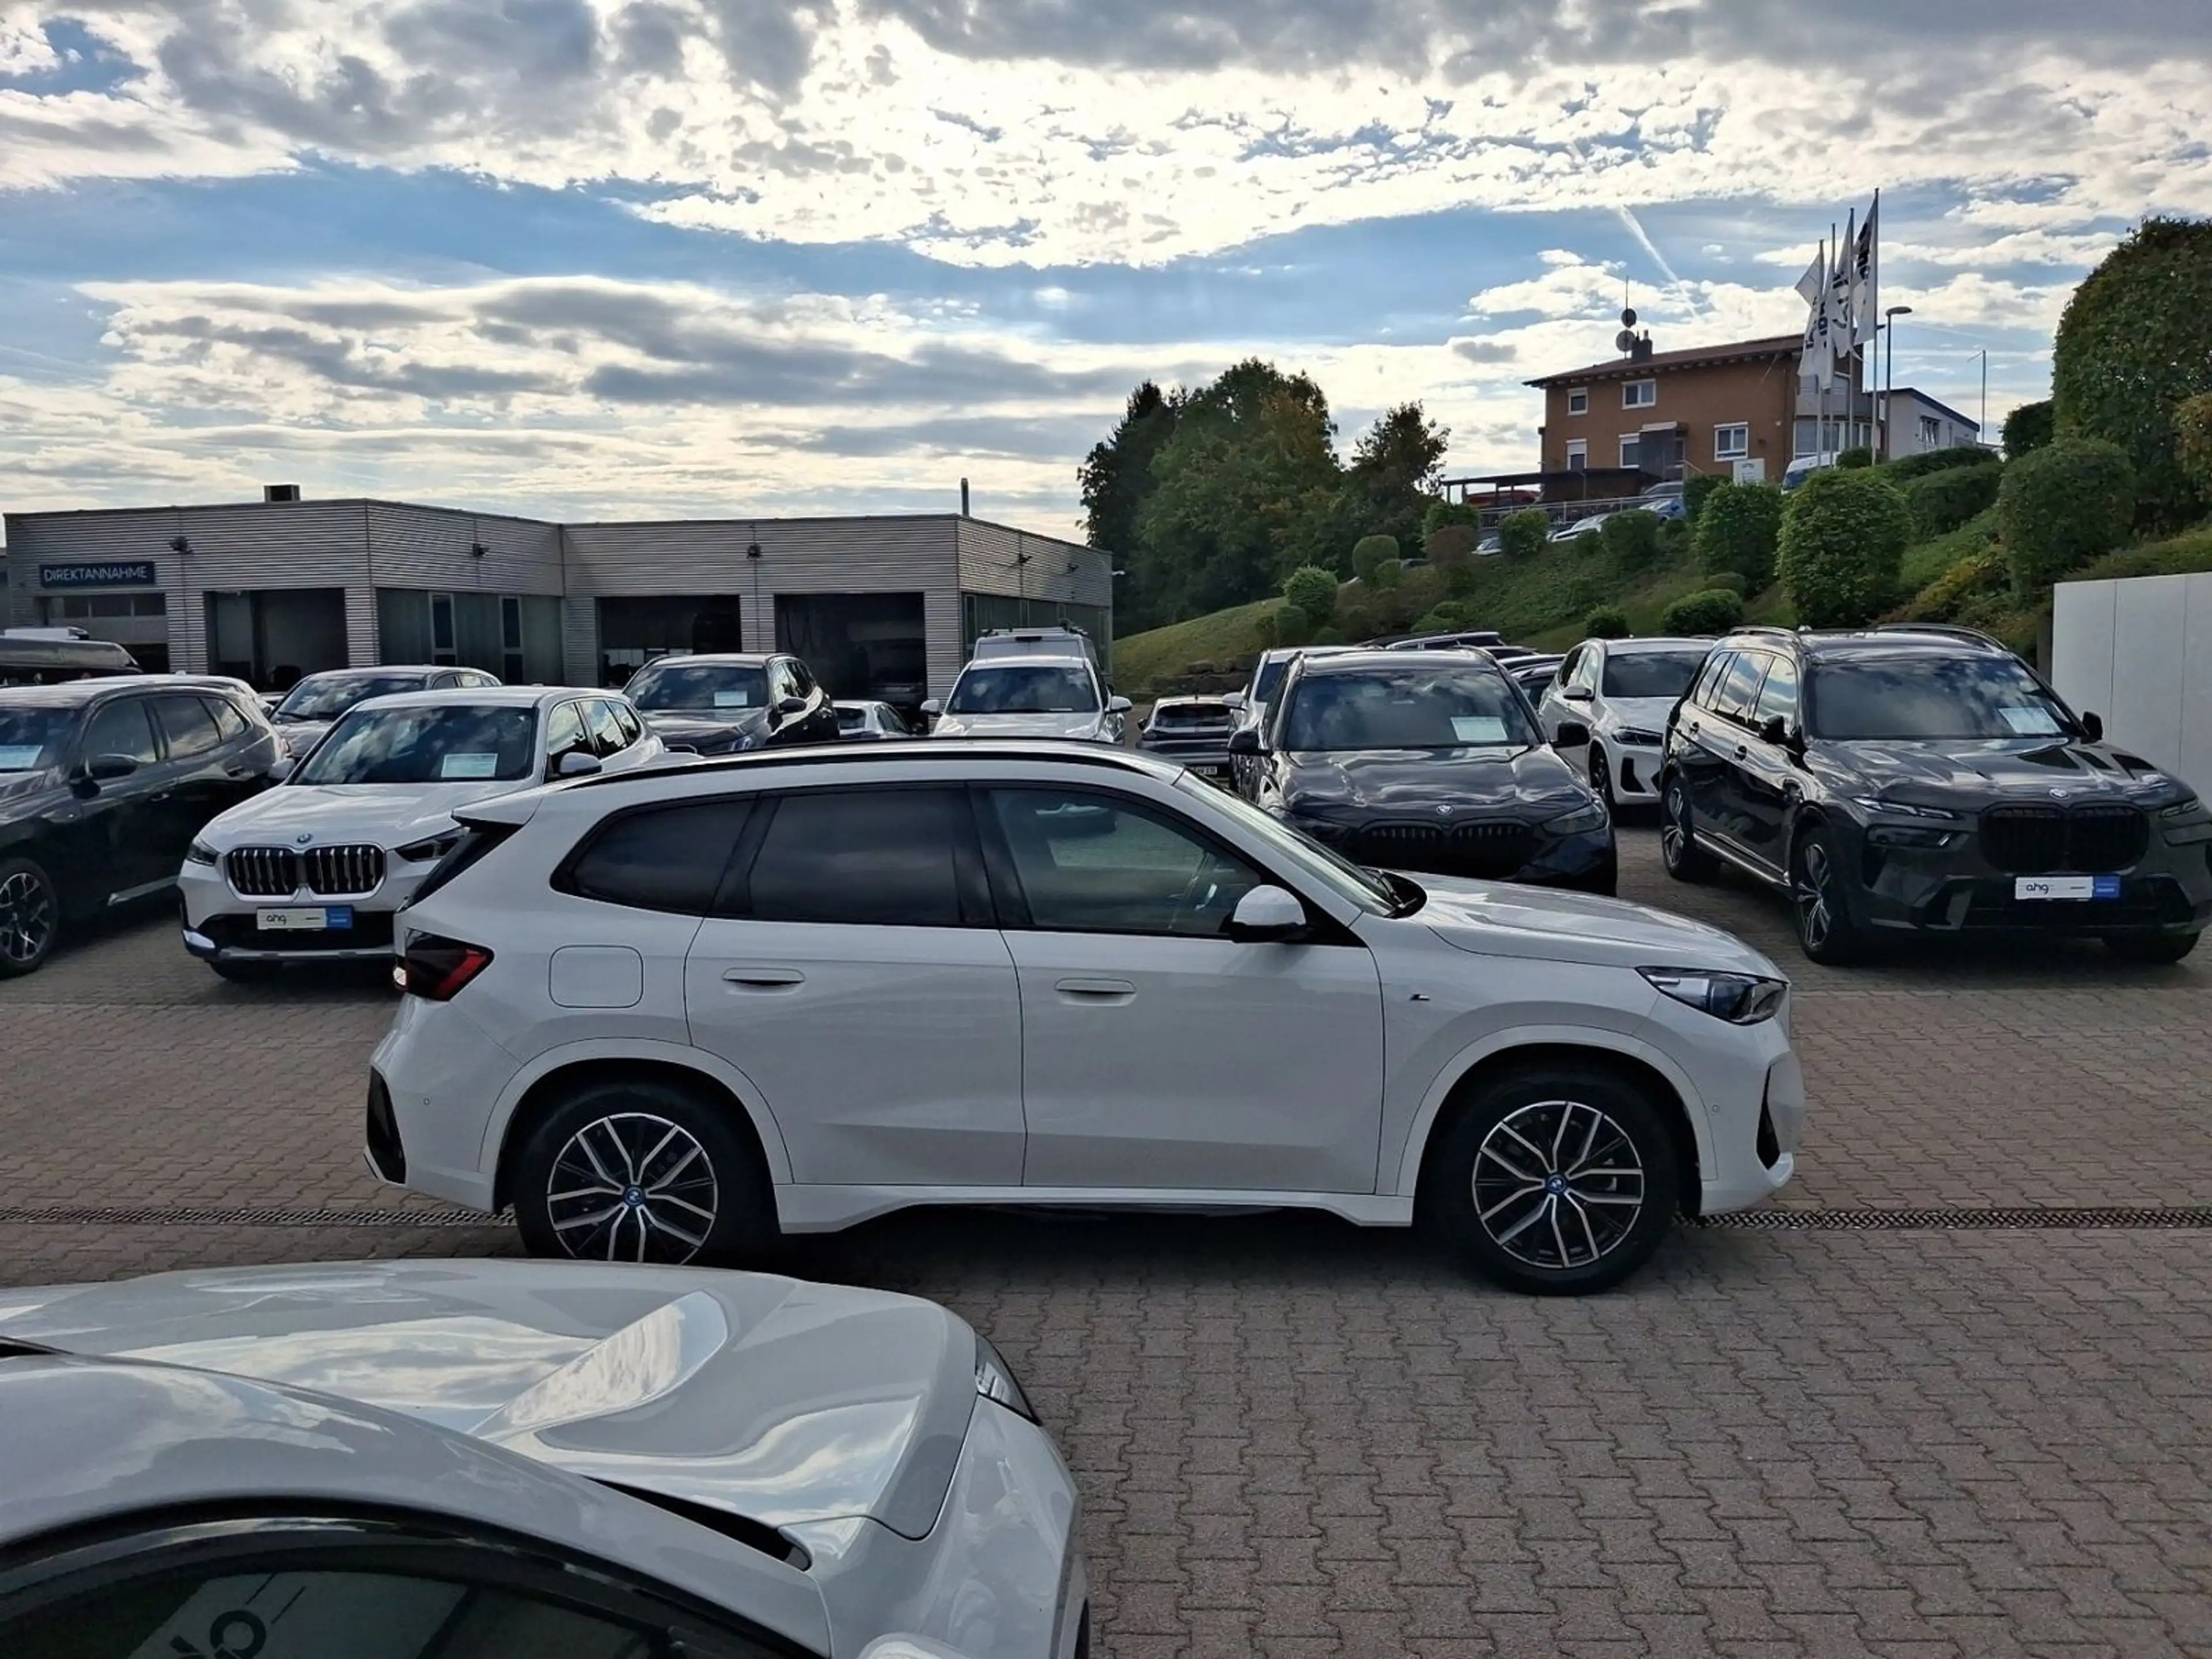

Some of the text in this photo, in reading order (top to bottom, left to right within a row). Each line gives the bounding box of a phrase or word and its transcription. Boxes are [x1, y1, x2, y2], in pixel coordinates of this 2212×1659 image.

[44, 566, 147, 582] DIREKTANNAHME
[2025, 882, 2049, 895] ahg
[266, 914, 286, 925] ahg
